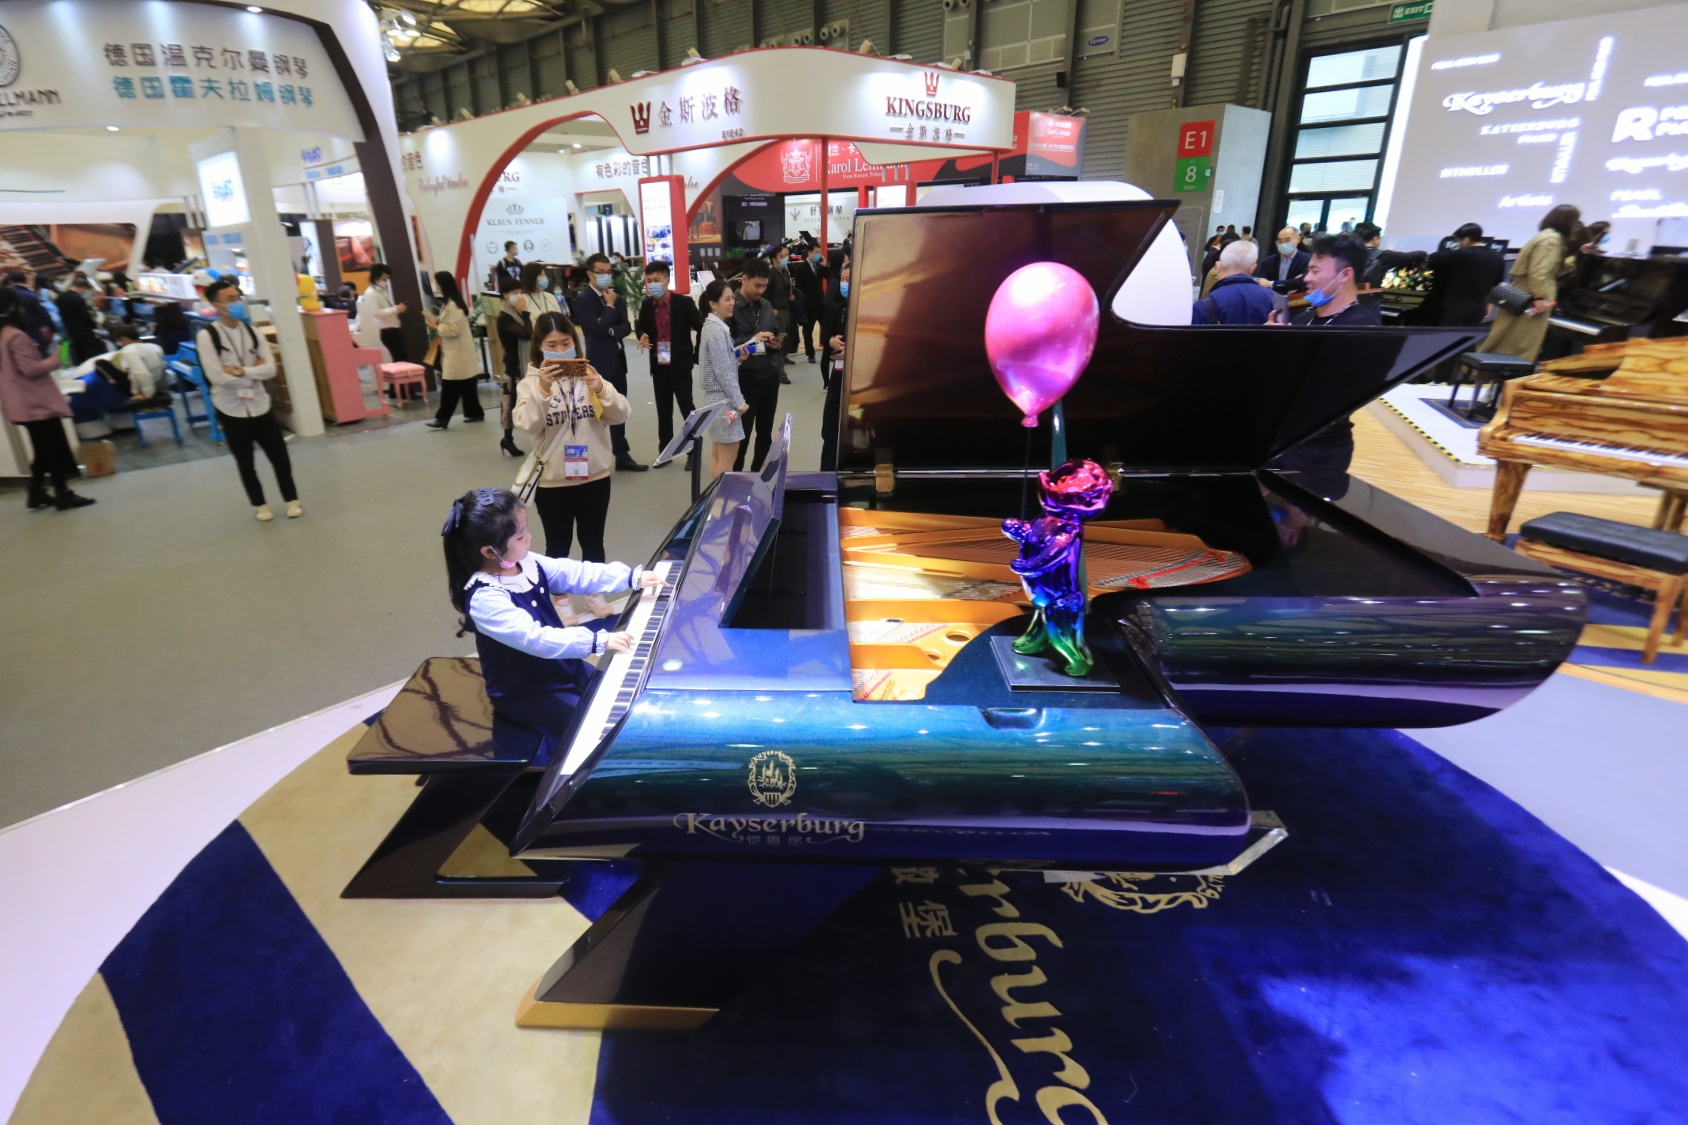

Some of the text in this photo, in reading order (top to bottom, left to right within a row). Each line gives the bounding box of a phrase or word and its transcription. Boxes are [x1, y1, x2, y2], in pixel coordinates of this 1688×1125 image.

[1405, 6, 1424, 14] EXIT
[658, 86, 743, 127] 金斯波格
[886, 96, 971, 124] KINGSBURG
[722, 128, 743, 139] E1E42
[905, 123, 953, 142] 金斯波格
[1185, 130, 1207, 149] E1
[498, 171, 520, 182] RG
[596, 159, 648, 178] 有色彩的音色
[1185, 166, 1197, 182] 8
[673, 813, 865, 843] Kayserburg
